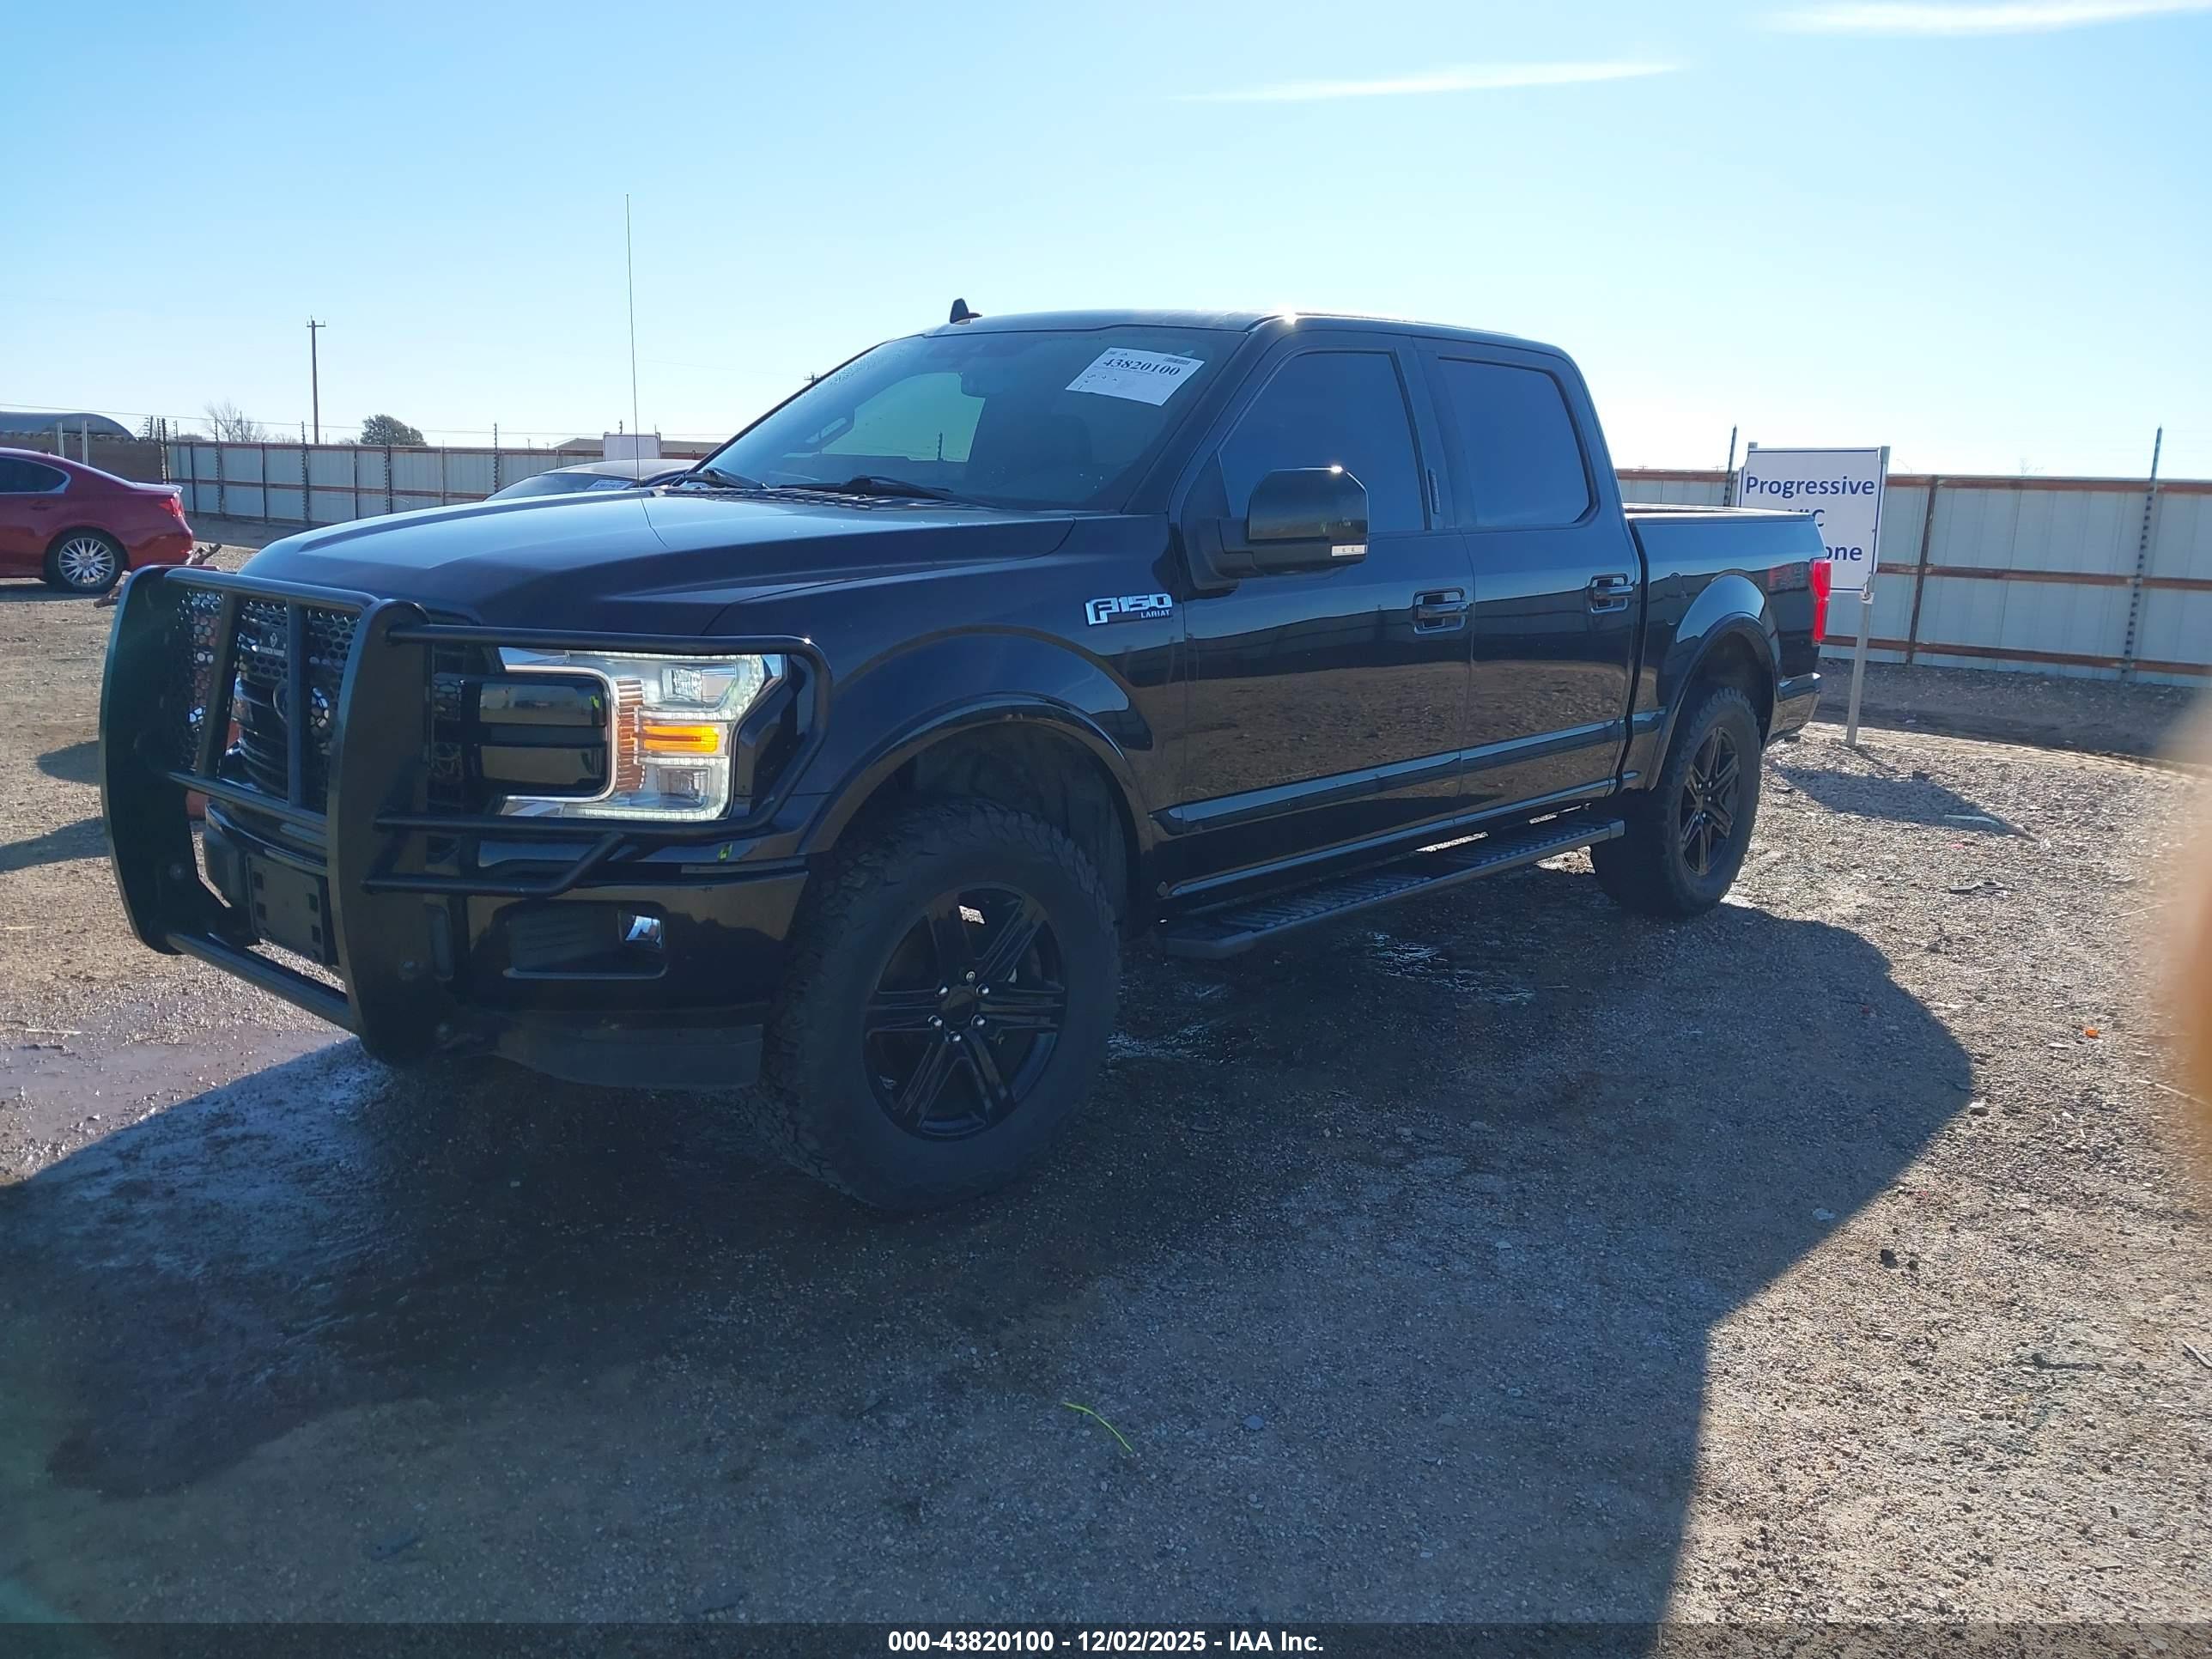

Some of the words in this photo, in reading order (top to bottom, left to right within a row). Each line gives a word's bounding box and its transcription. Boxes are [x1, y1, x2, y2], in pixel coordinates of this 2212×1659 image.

[1103, 358, 1181, 376] 43820100
[1746, 476, 1875, 499] Progressive
[1140, 610, 1170, 618] LARIAT
